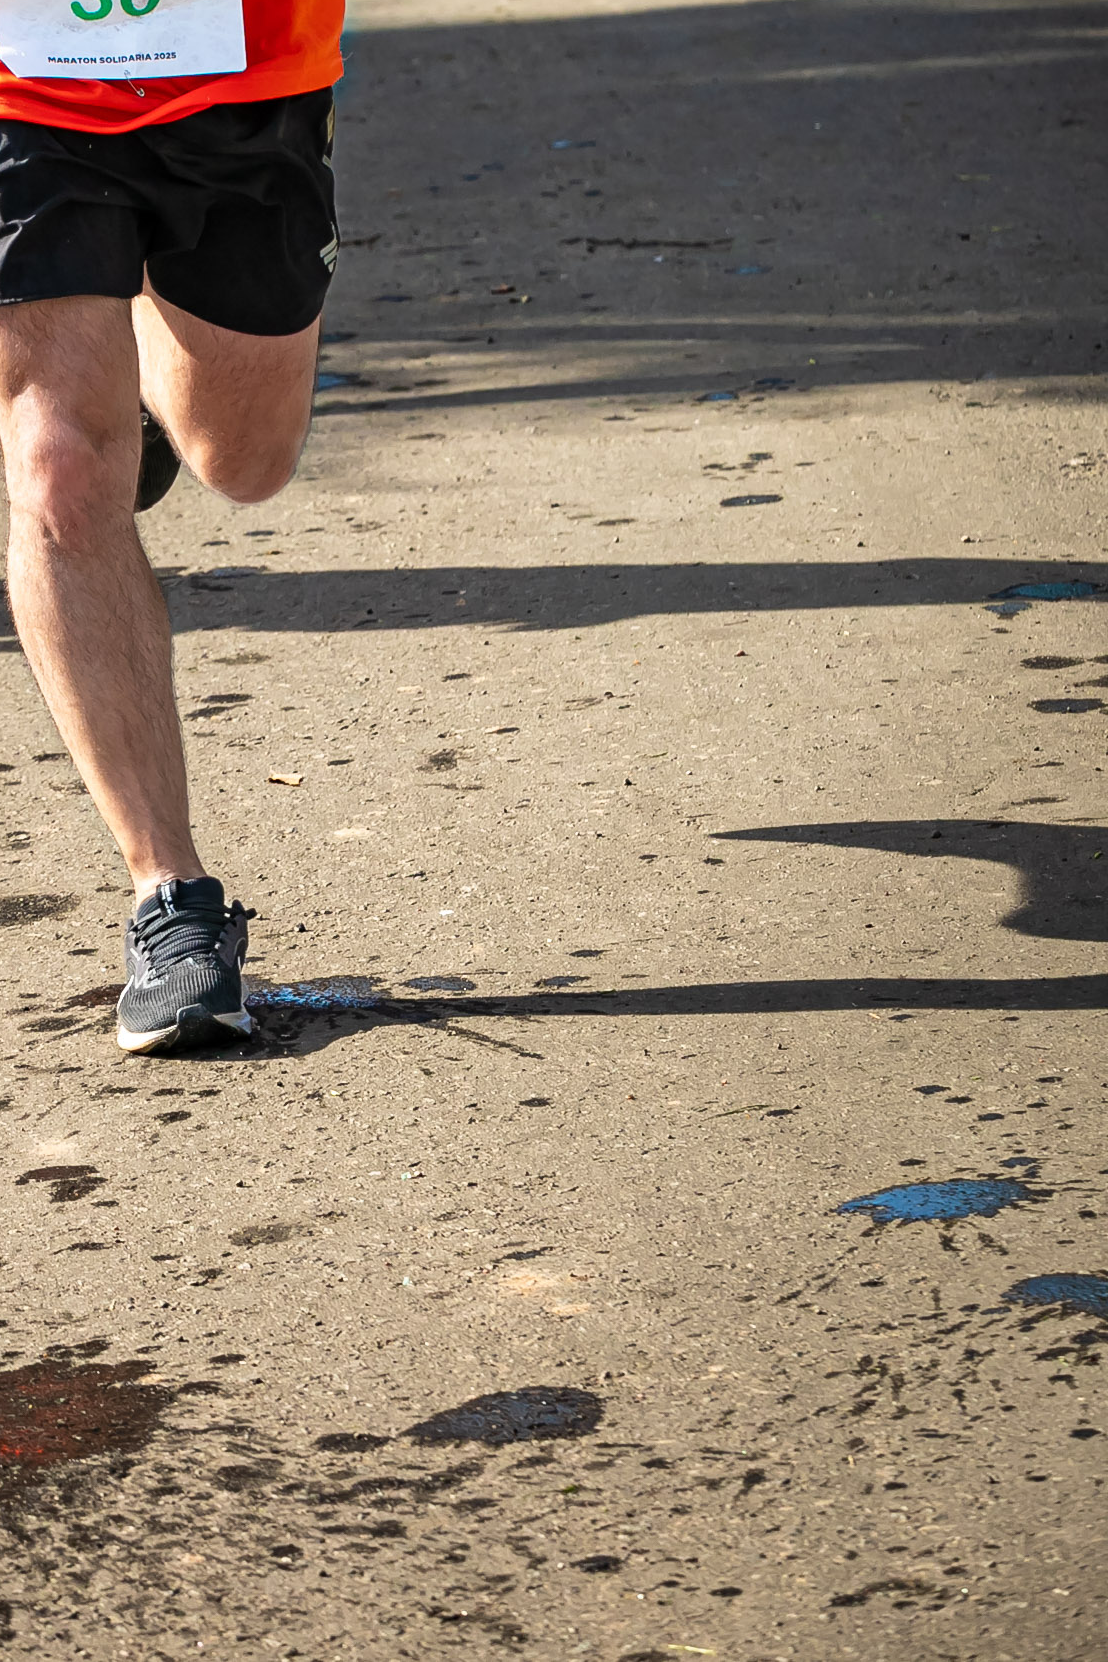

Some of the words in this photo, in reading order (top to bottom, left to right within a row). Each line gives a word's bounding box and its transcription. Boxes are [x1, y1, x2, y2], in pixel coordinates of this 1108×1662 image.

[47, 56, 97, 65] MARATON
[98, 53, 152, 64] SOLIDARIA
[153, 51, 177, 60] 2025
